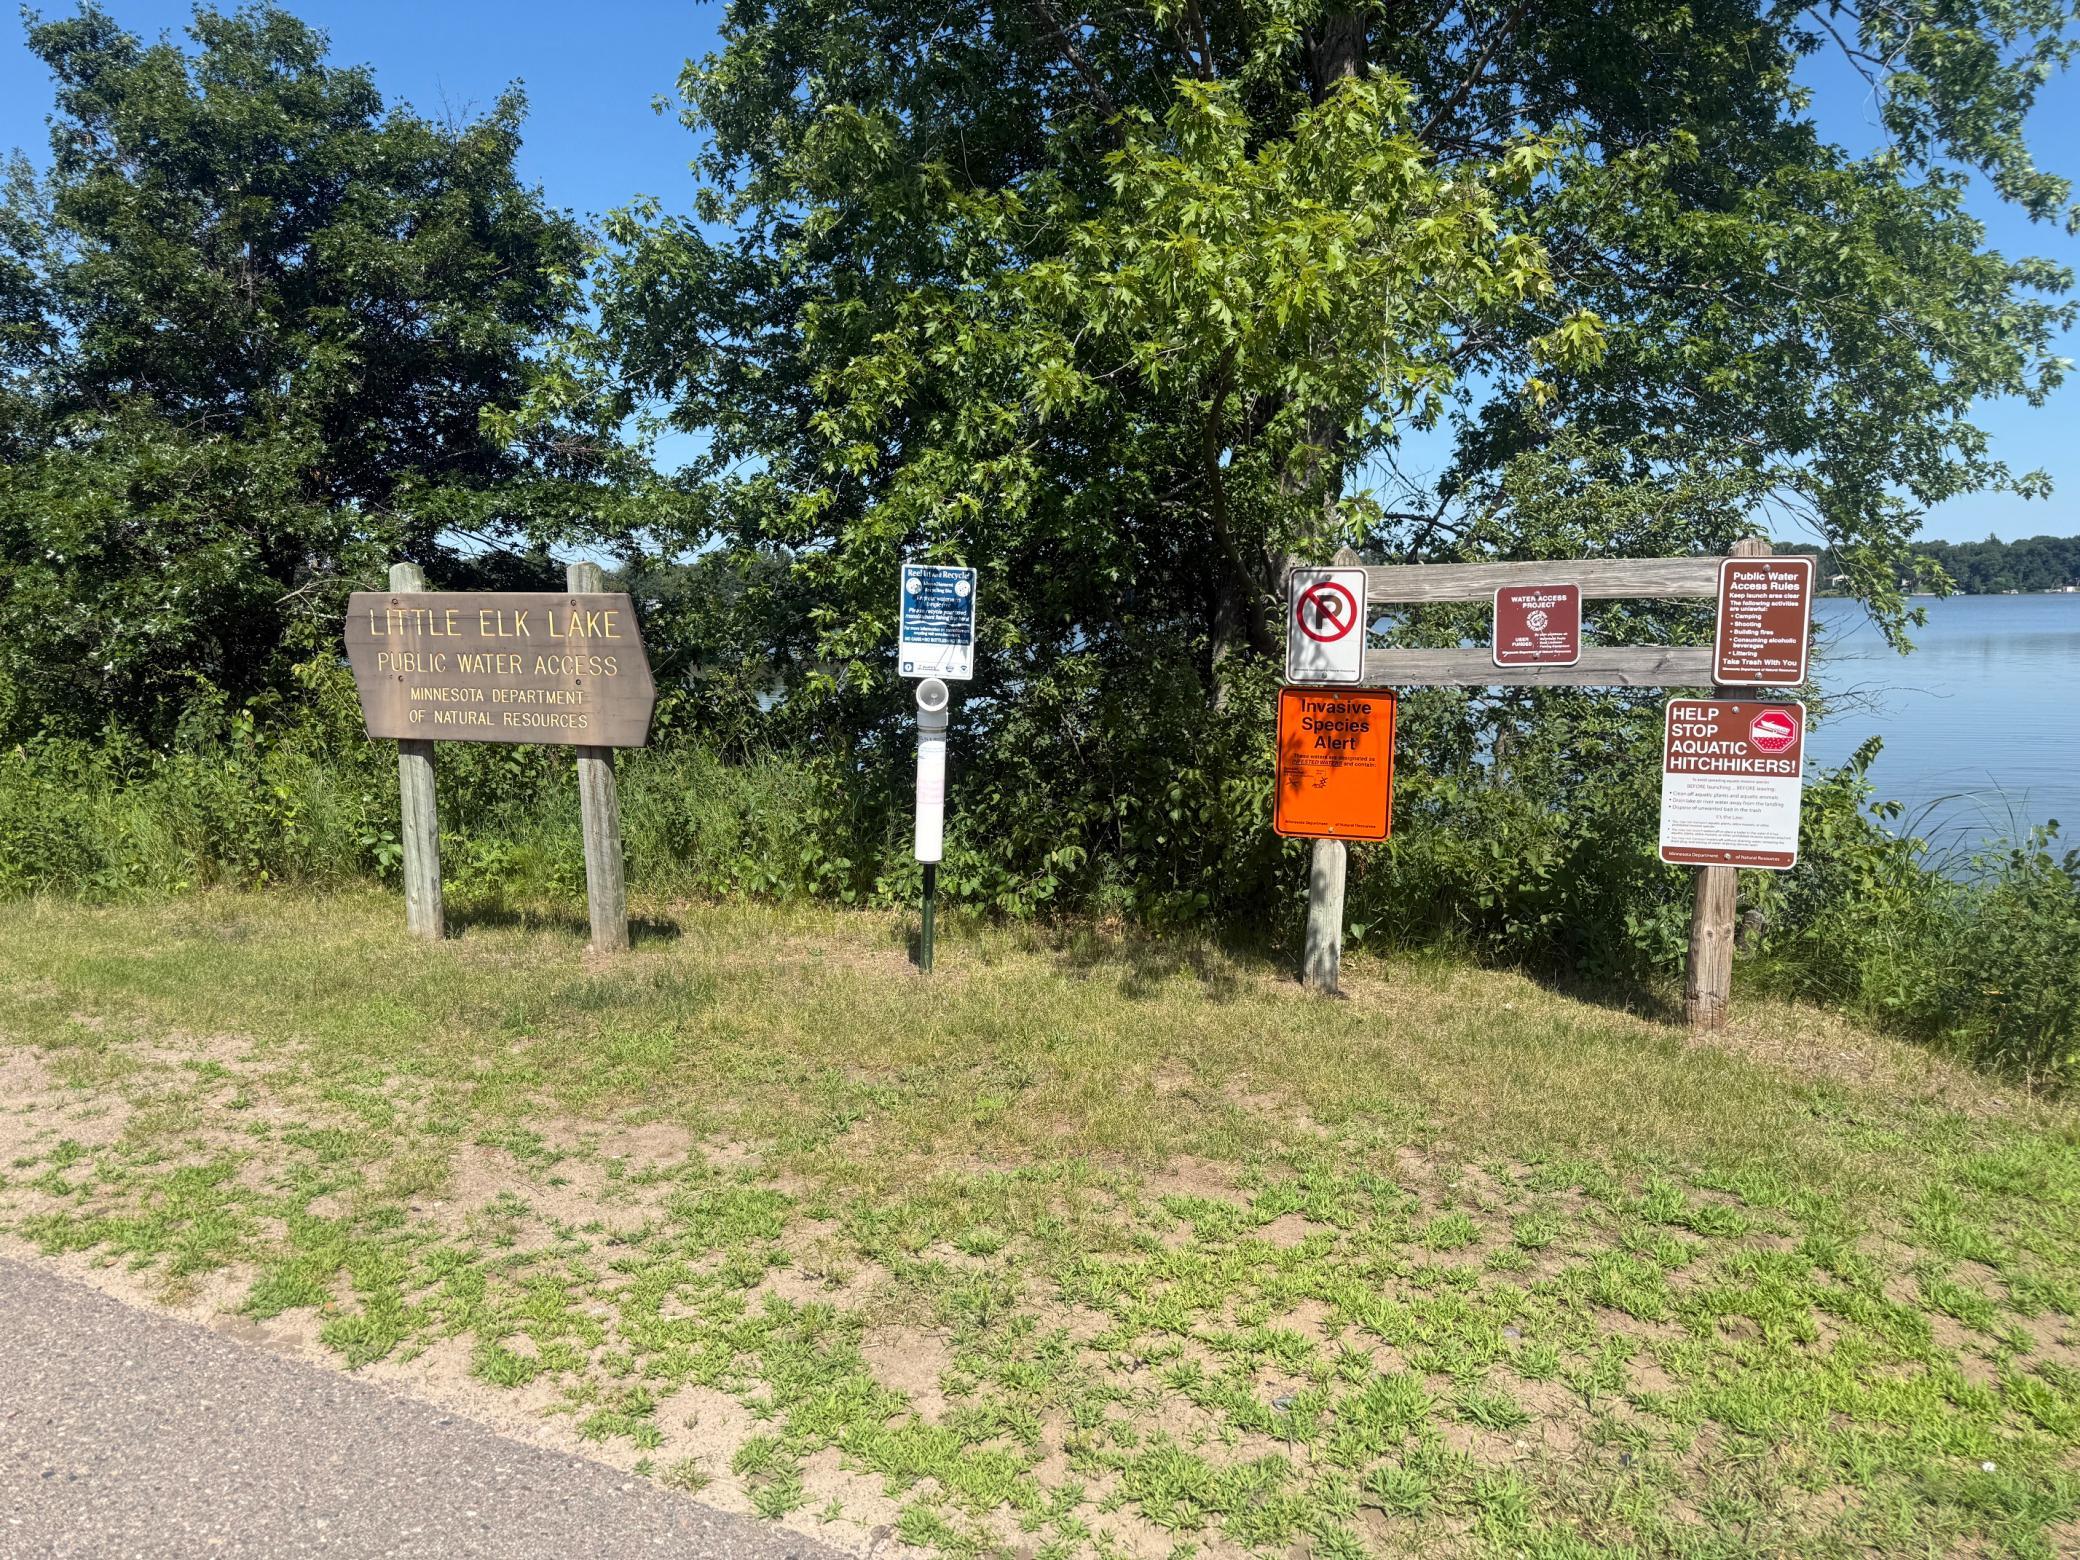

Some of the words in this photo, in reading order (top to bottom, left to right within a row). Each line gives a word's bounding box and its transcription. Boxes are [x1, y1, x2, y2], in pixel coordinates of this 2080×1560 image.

[1734, 572, 1765, 580] Public
[1768, 572, 1798, 580] Water
[1730, 582, 1767, 590] Access
[1770, 582, 1800, 590] Rules
[369, 608, 462, 636] LITTLE
[480, 609, 530, 637] ELK
[548, 610, 621, 638] LAKE
[378, 652, 446, 673] PUBLIC
[456, 653, 522, 674] WATER
[534, 655, 618, 676] ACCESS
[411, 687, 484, 702] MINNESOTA
[492, 689, 584, 704] DEPARTMENT
[1301, 699, 1372, 714] Invasive
[1672, 707, 1719, 720] HELP
[409, 710, 426, 723] OF
[434, 710, 495, 726] NATURAL
[503, 712, 588, 728] RESOURCES
[1302, 717, 1370, 734] Species
[1672, 724, 1718, 737] STOP
[1314, 736, 1356, 750] Alert
[1670, 740, 1747, 755] AQUATIC
[1670, 756, 1796, 773] HITCHHIKERS!
